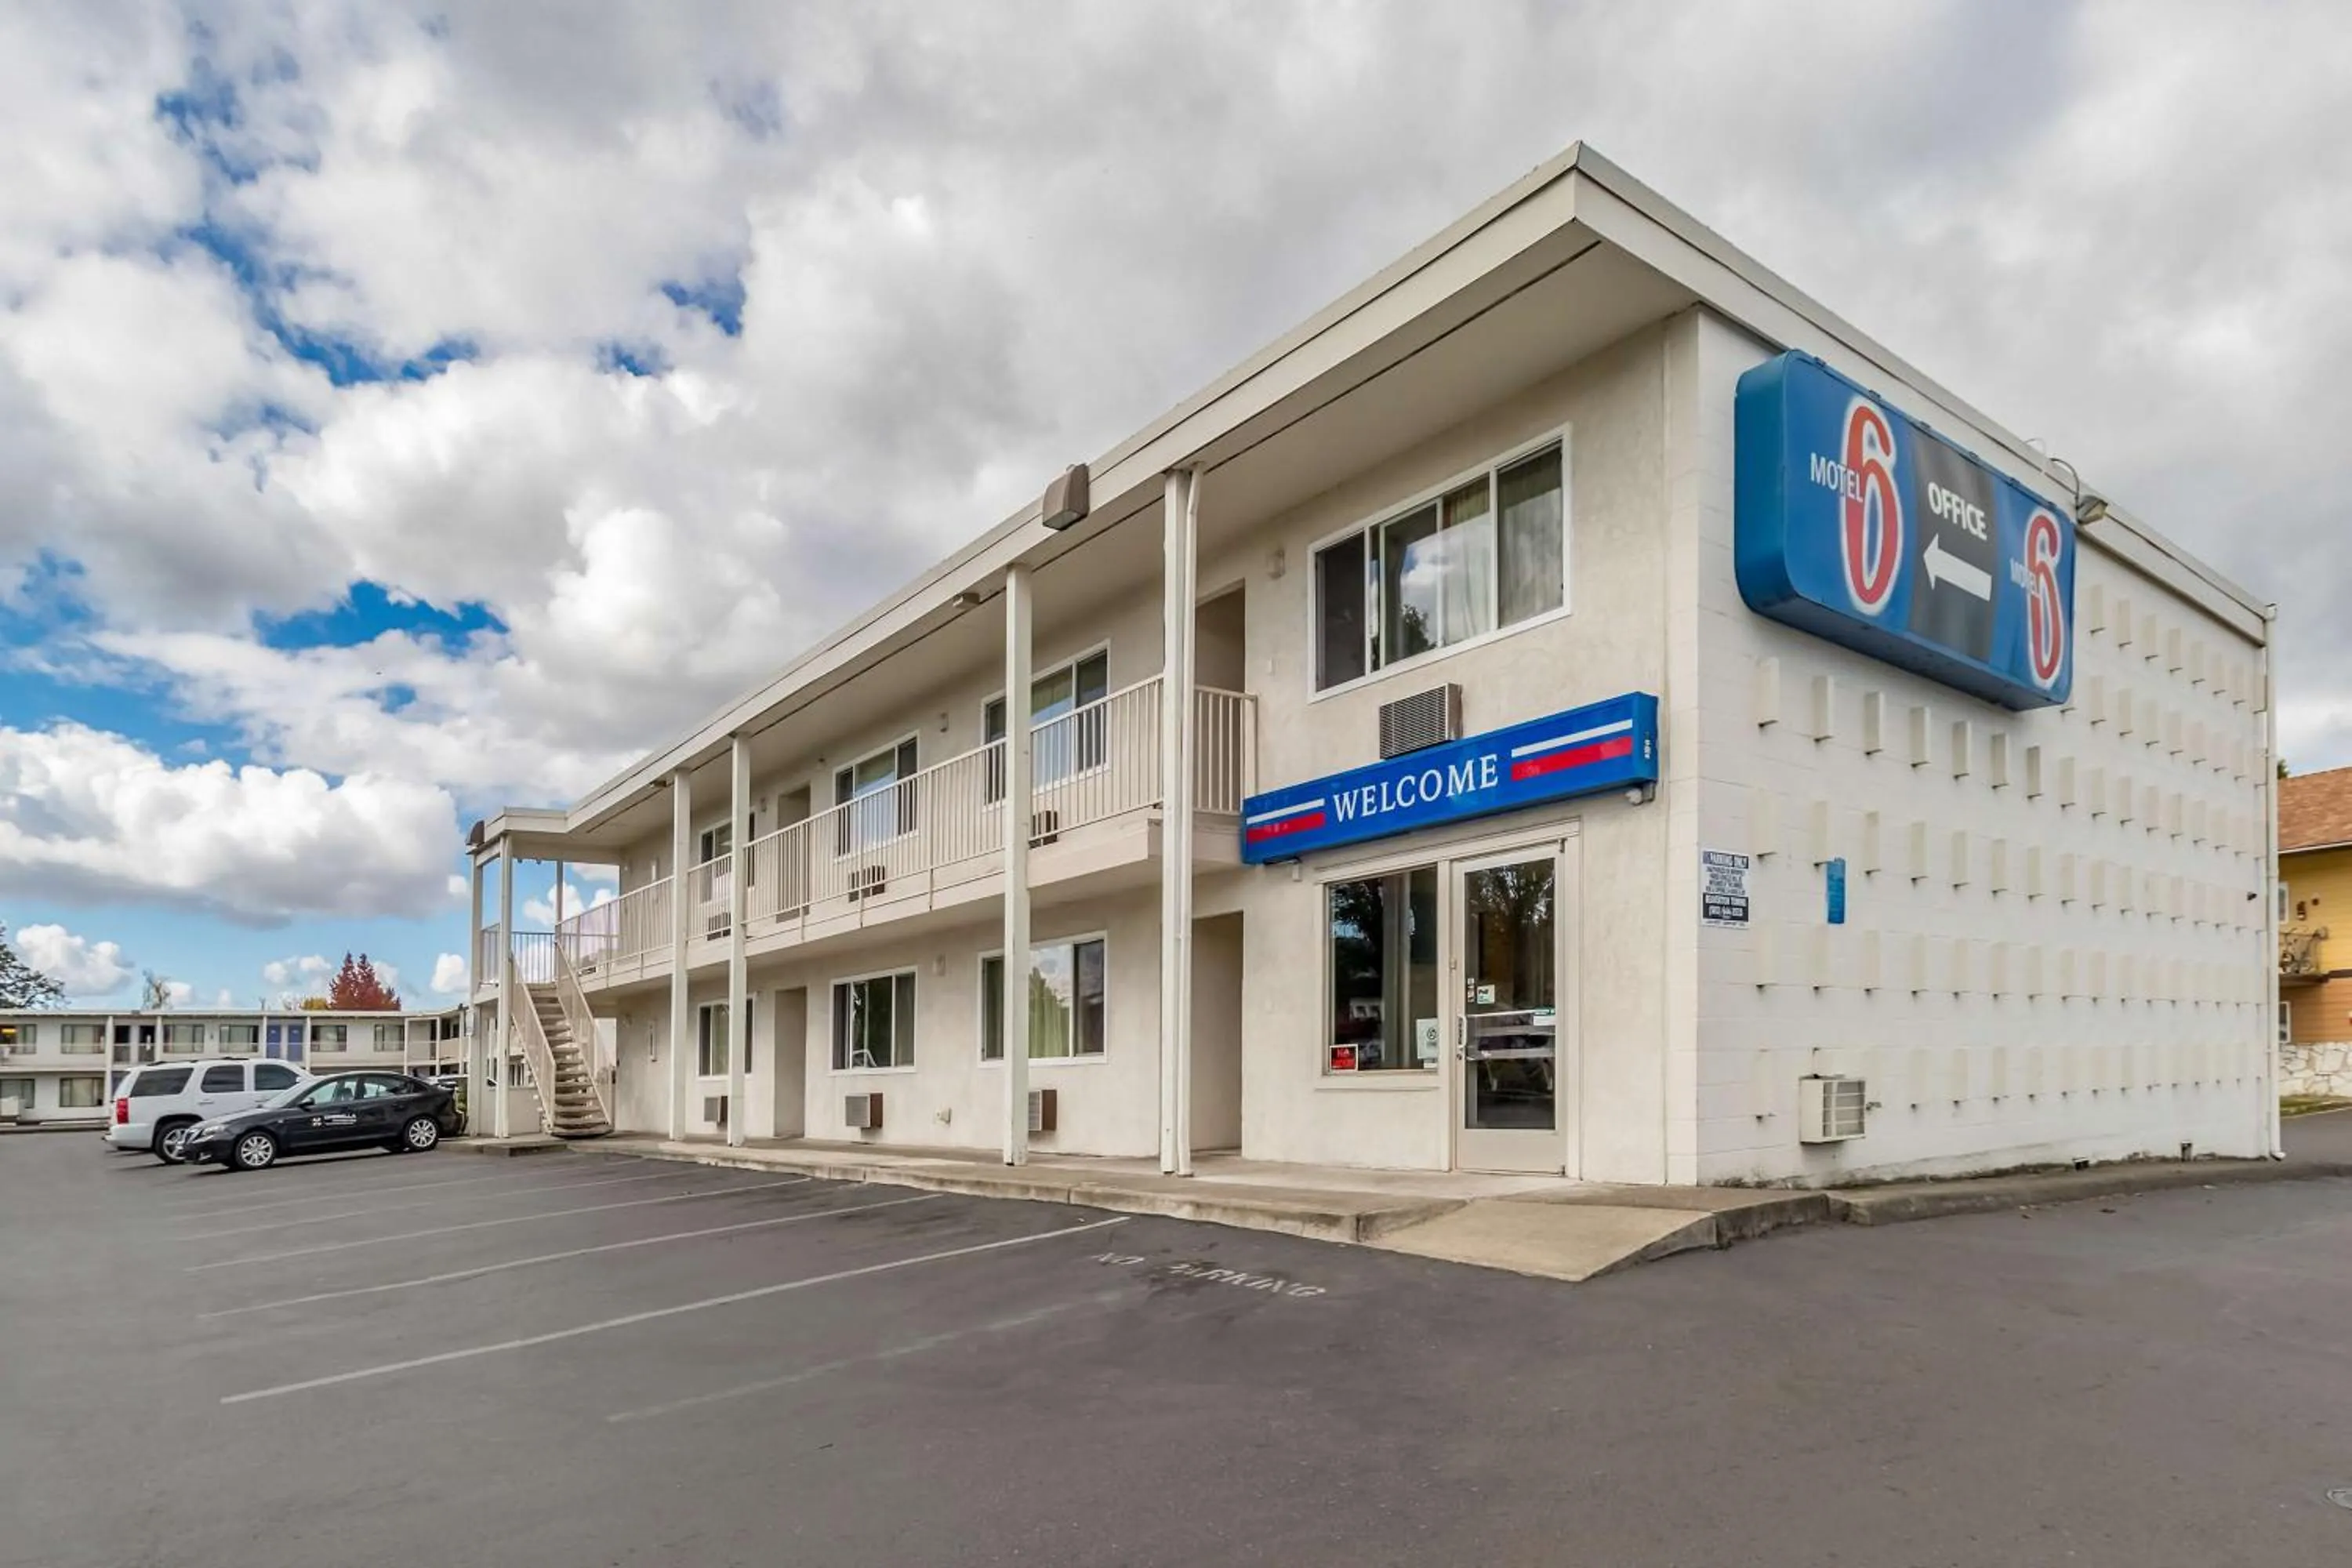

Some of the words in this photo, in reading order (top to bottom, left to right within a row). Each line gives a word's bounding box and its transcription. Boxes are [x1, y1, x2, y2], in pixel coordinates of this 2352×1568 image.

[1810, 452, 1864, 503] MOTEL
[1842, 399, 1901, 612] 6
[1928, 481, 1987, 541] OFFICE
[2025, 508, 2063, 685] 6
[1332, 753, 1499, 823] WELCOME
[1090, 1251, 1145, 1265] NO
